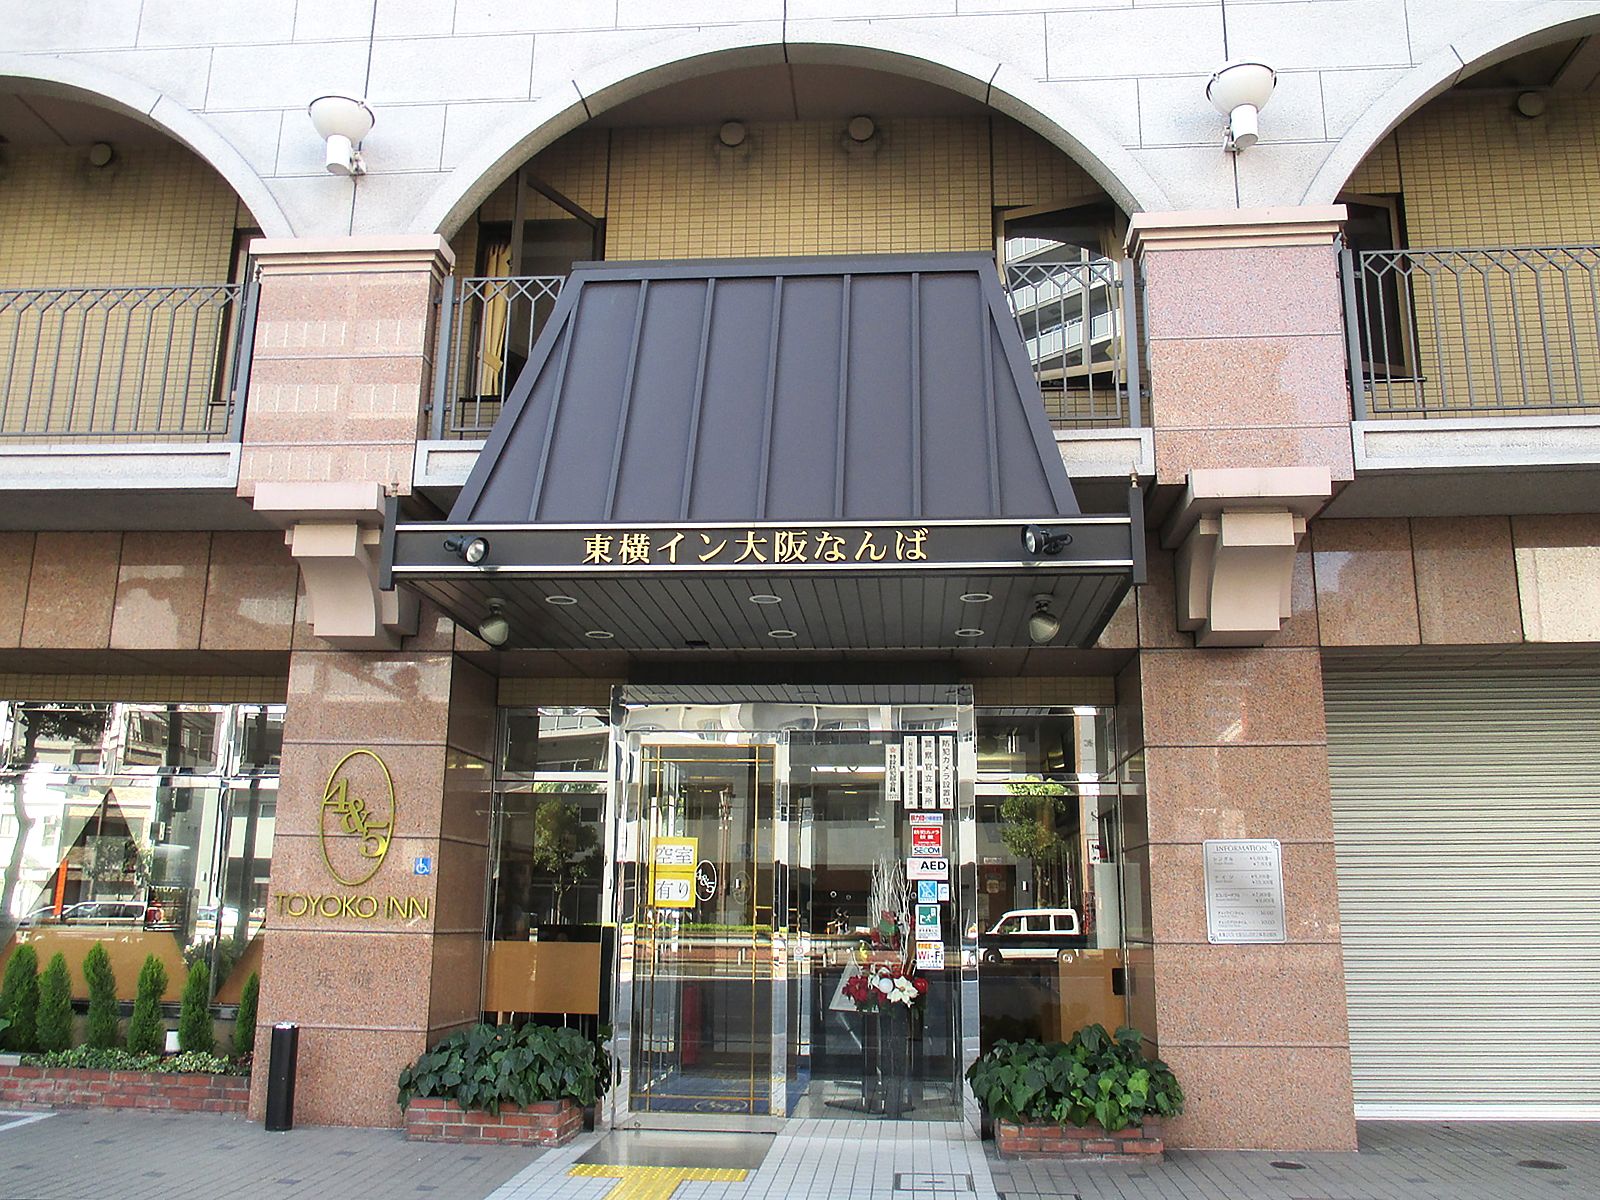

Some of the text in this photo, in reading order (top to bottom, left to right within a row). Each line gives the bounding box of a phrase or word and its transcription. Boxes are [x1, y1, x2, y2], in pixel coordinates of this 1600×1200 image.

[582, 527, 929, 564] 東横イン大阪なんば
[924, 739, 934, 806] 警察官立寄所
[941, 739, 951, 806] 防犯カメラ設置店
[656, 846, 694, 866] 空室
[914, 846, 940, 854] SECOM
[920, 860, 947, 871] AED
[656, 880, 690, 900] 有り
[274, 893, 430, 919] TOYOKO INN
[917, 950, 944, 960] Wi-Fi
